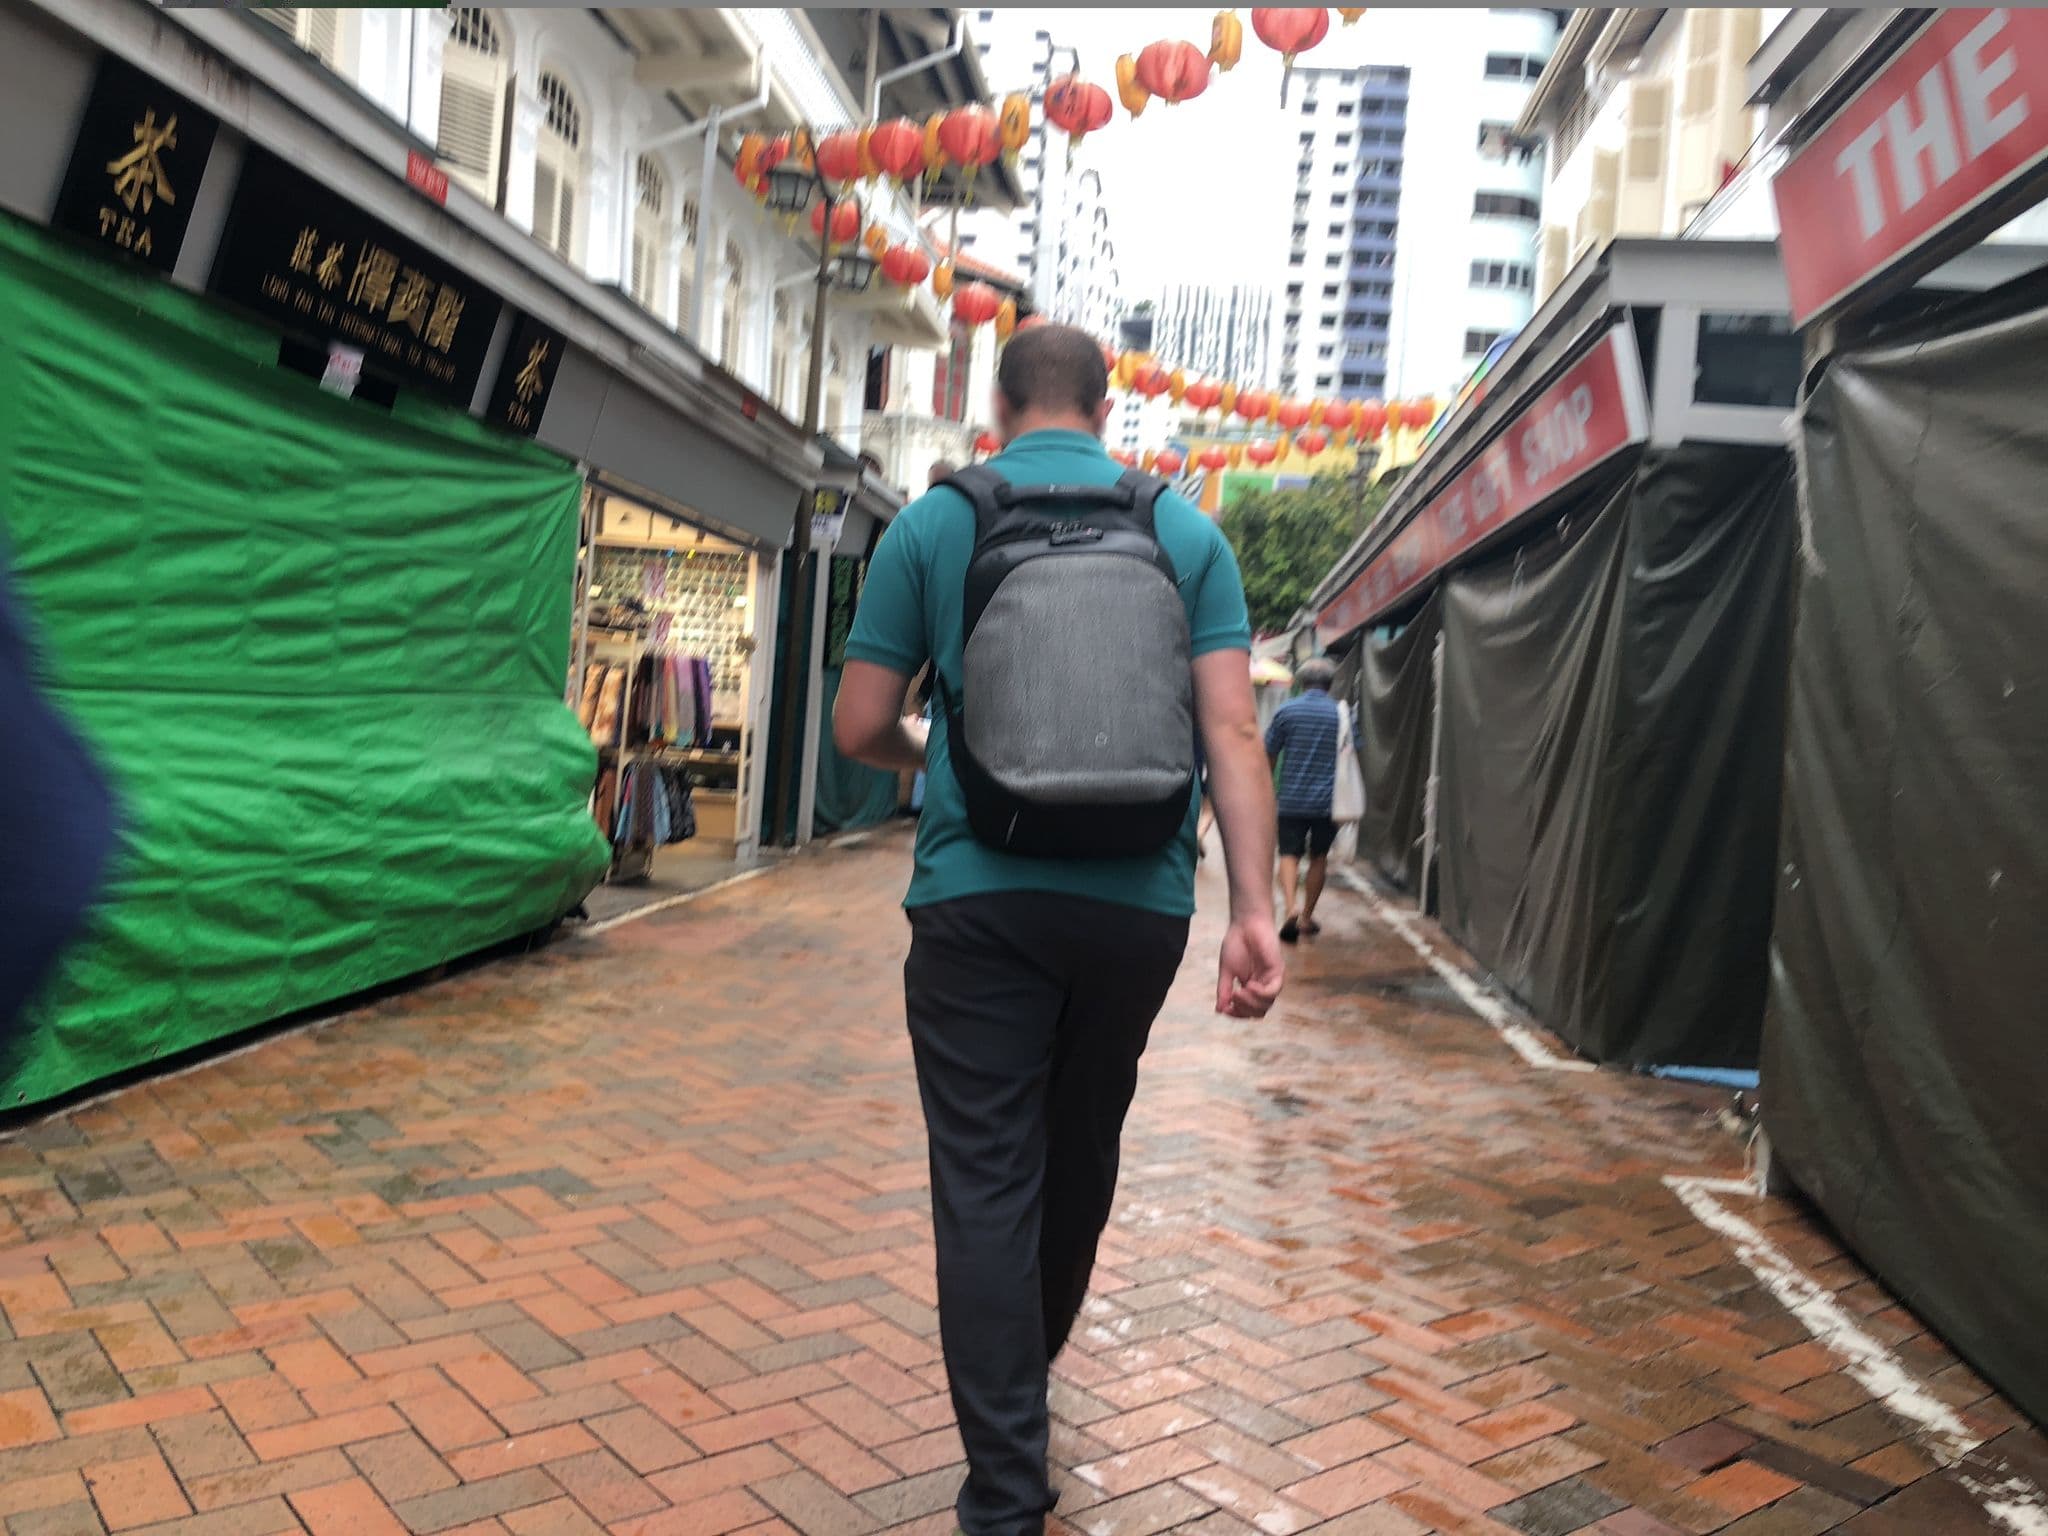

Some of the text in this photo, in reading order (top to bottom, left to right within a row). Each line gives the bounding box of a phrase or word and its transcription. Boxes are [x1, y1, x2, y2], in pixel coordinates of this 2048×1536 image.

[106, 106, 177, 214] 茶
[1835, 8, 2030, 242] THE
[99, 206, 152, 257] TEA
[1521, 383, 1593, 486] SHOP
